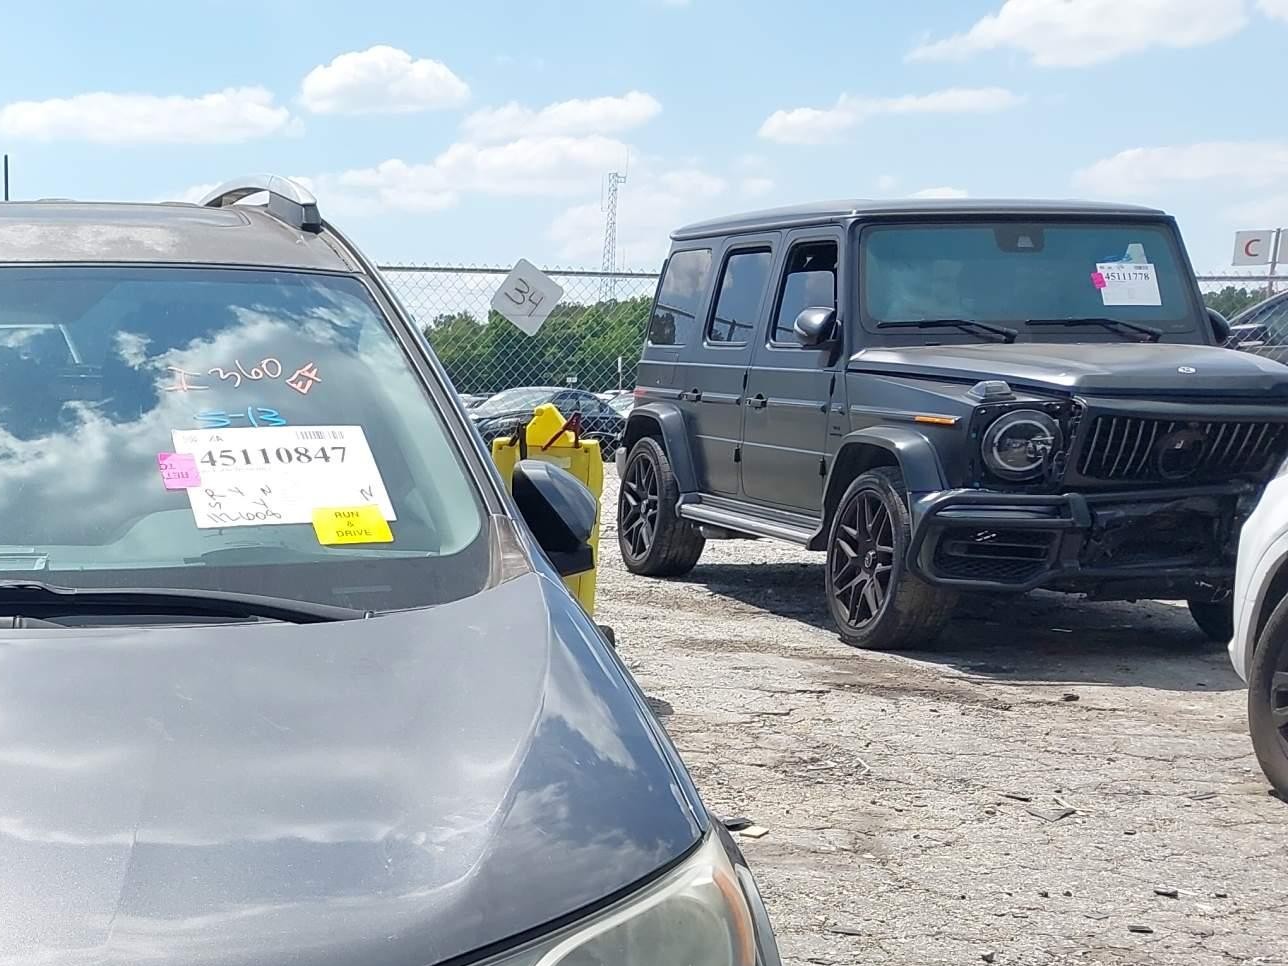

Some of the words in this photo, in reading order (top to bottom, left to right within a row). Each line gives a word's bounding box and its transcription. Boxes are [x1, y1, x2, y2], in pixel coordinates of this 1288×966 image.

[1244, 239, 1261, 257] C
[1104, 272, 1150, 281] 45111778
[504, 278, 544, 317] 34
[208, 358, 282, 389] 360
[200, 446, 347, 466] 45110847
[334, 511, 360, 519] RUN
[336, 529, 373, 538] DRIVE
